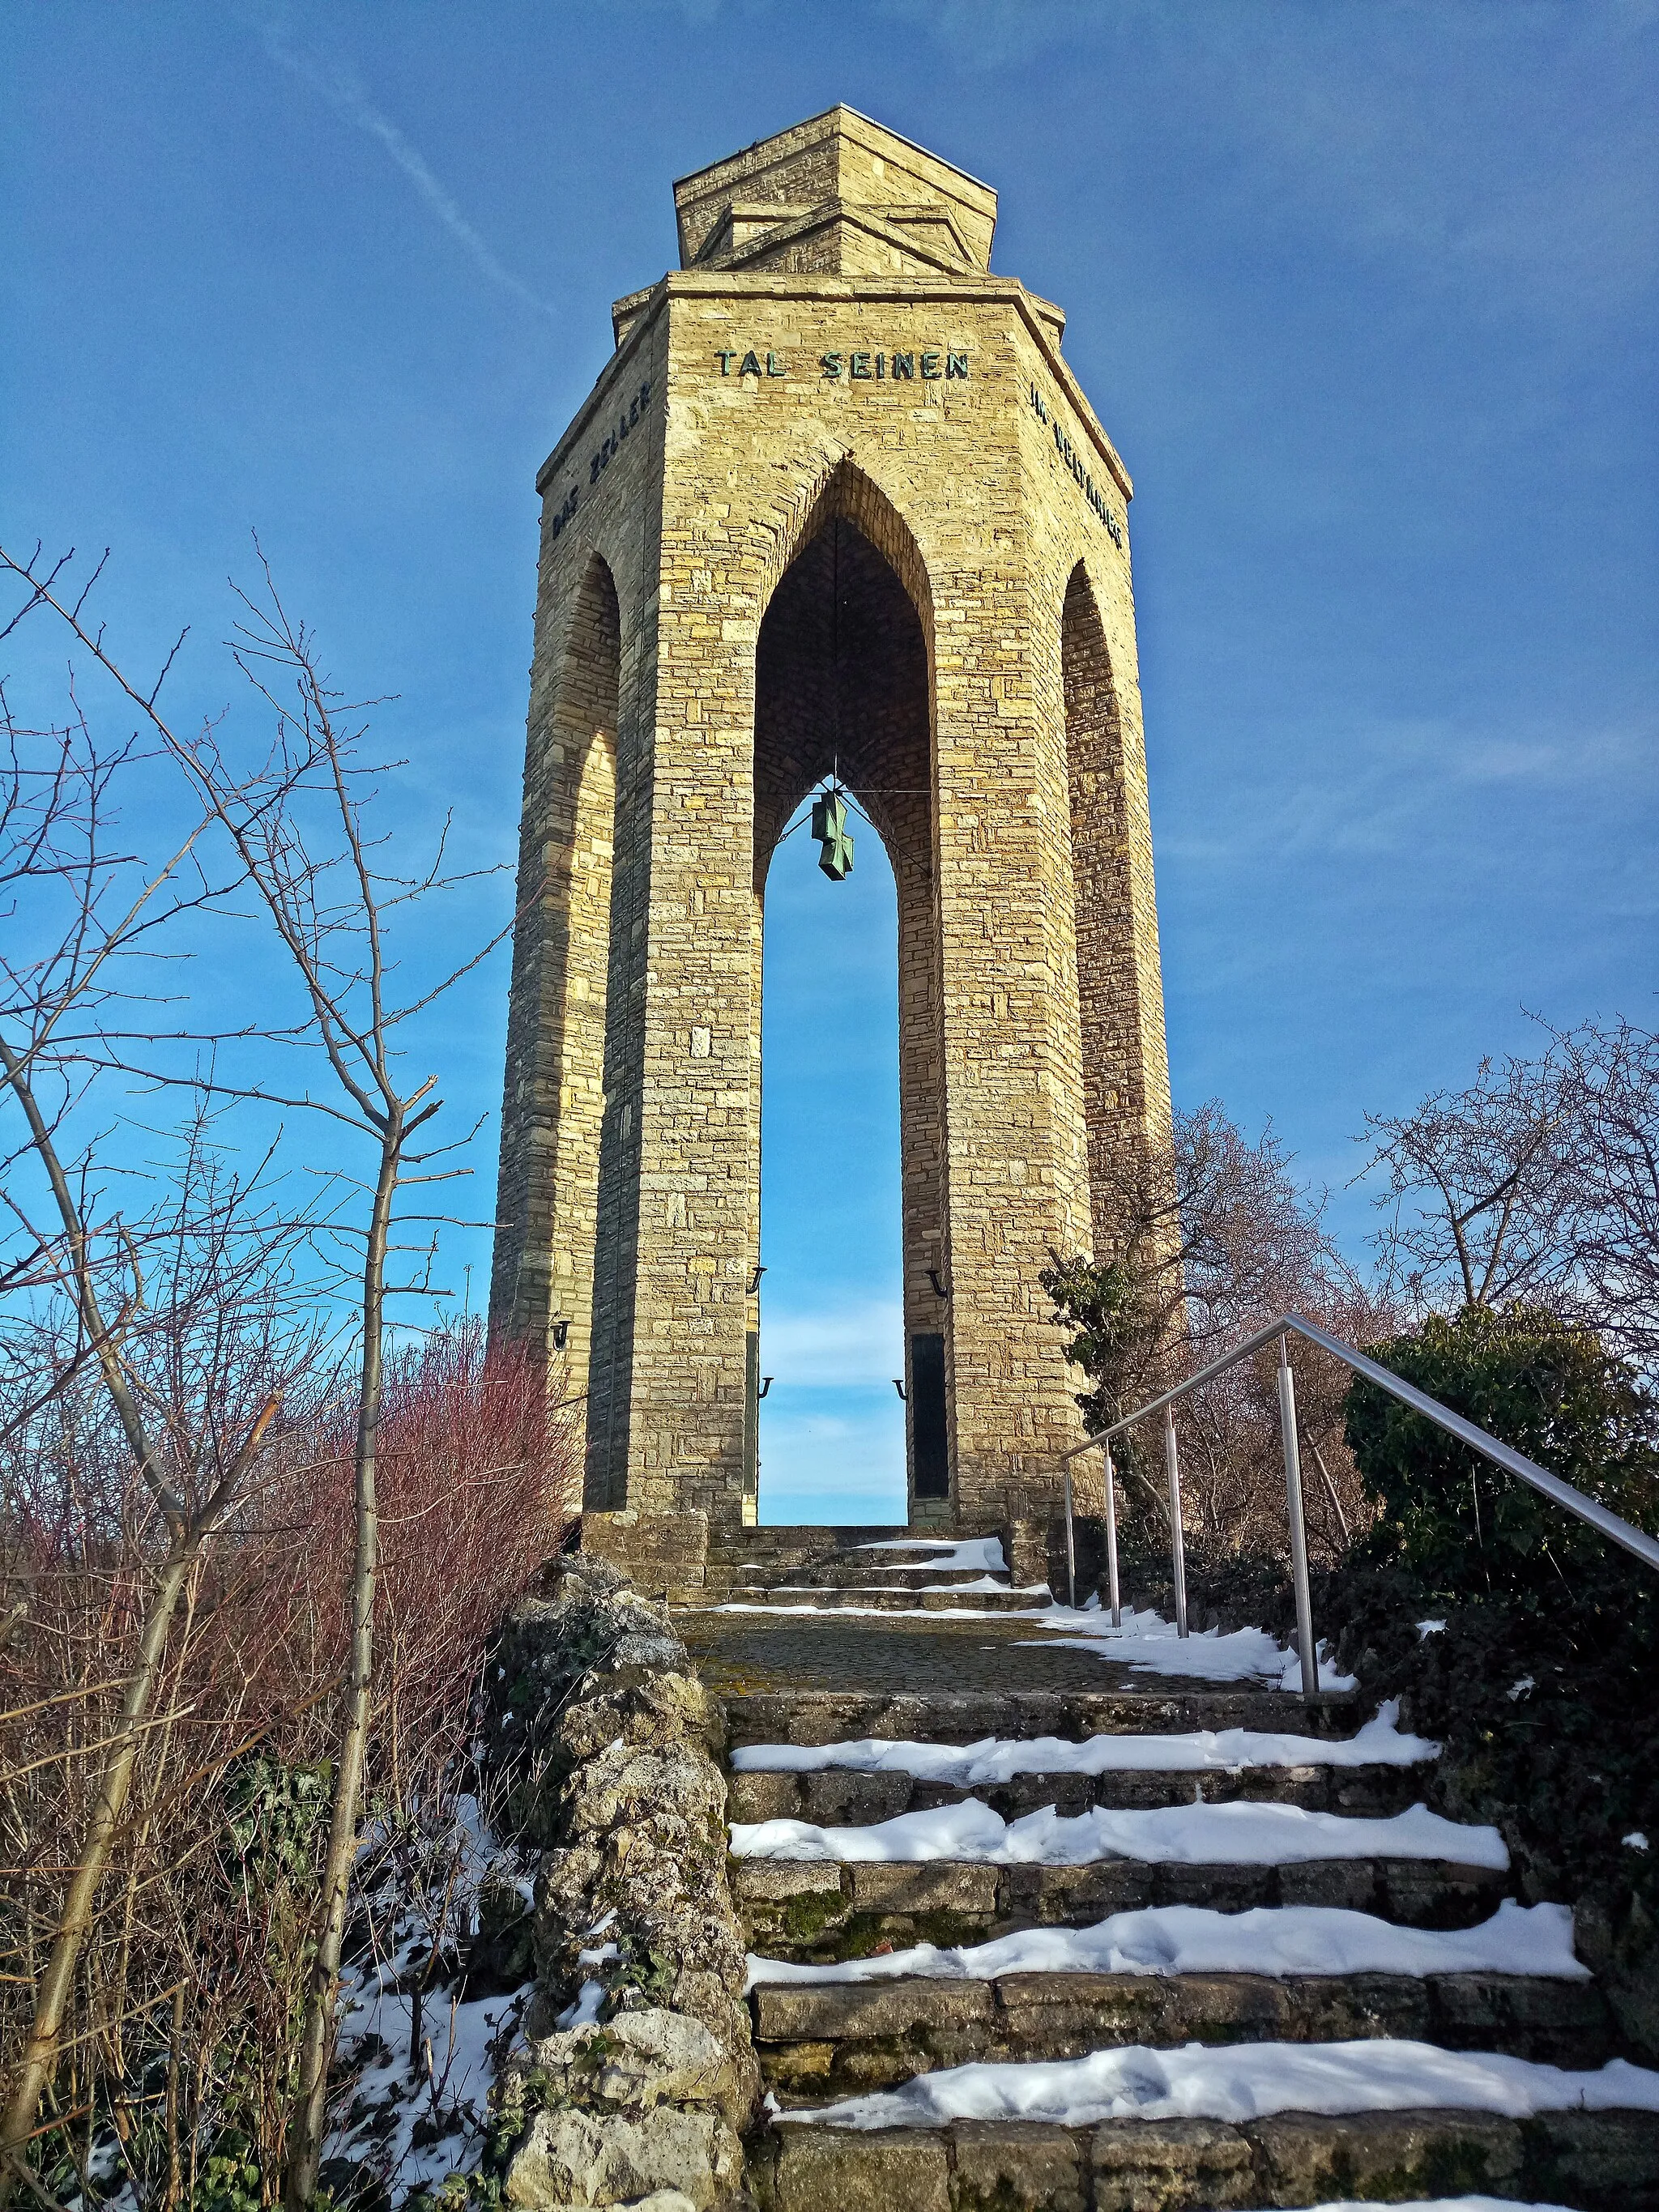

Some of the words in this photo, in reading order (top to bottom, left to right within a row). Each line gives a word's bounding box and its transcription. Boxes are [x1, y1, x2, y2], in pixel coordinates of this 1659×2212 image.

[714, 350, 785, 377] TAL
[820, 351, 969, 380] SEINEN
[1030, 381, 1047, 425] IM
[590, 381, 650, 484] ZELLER
